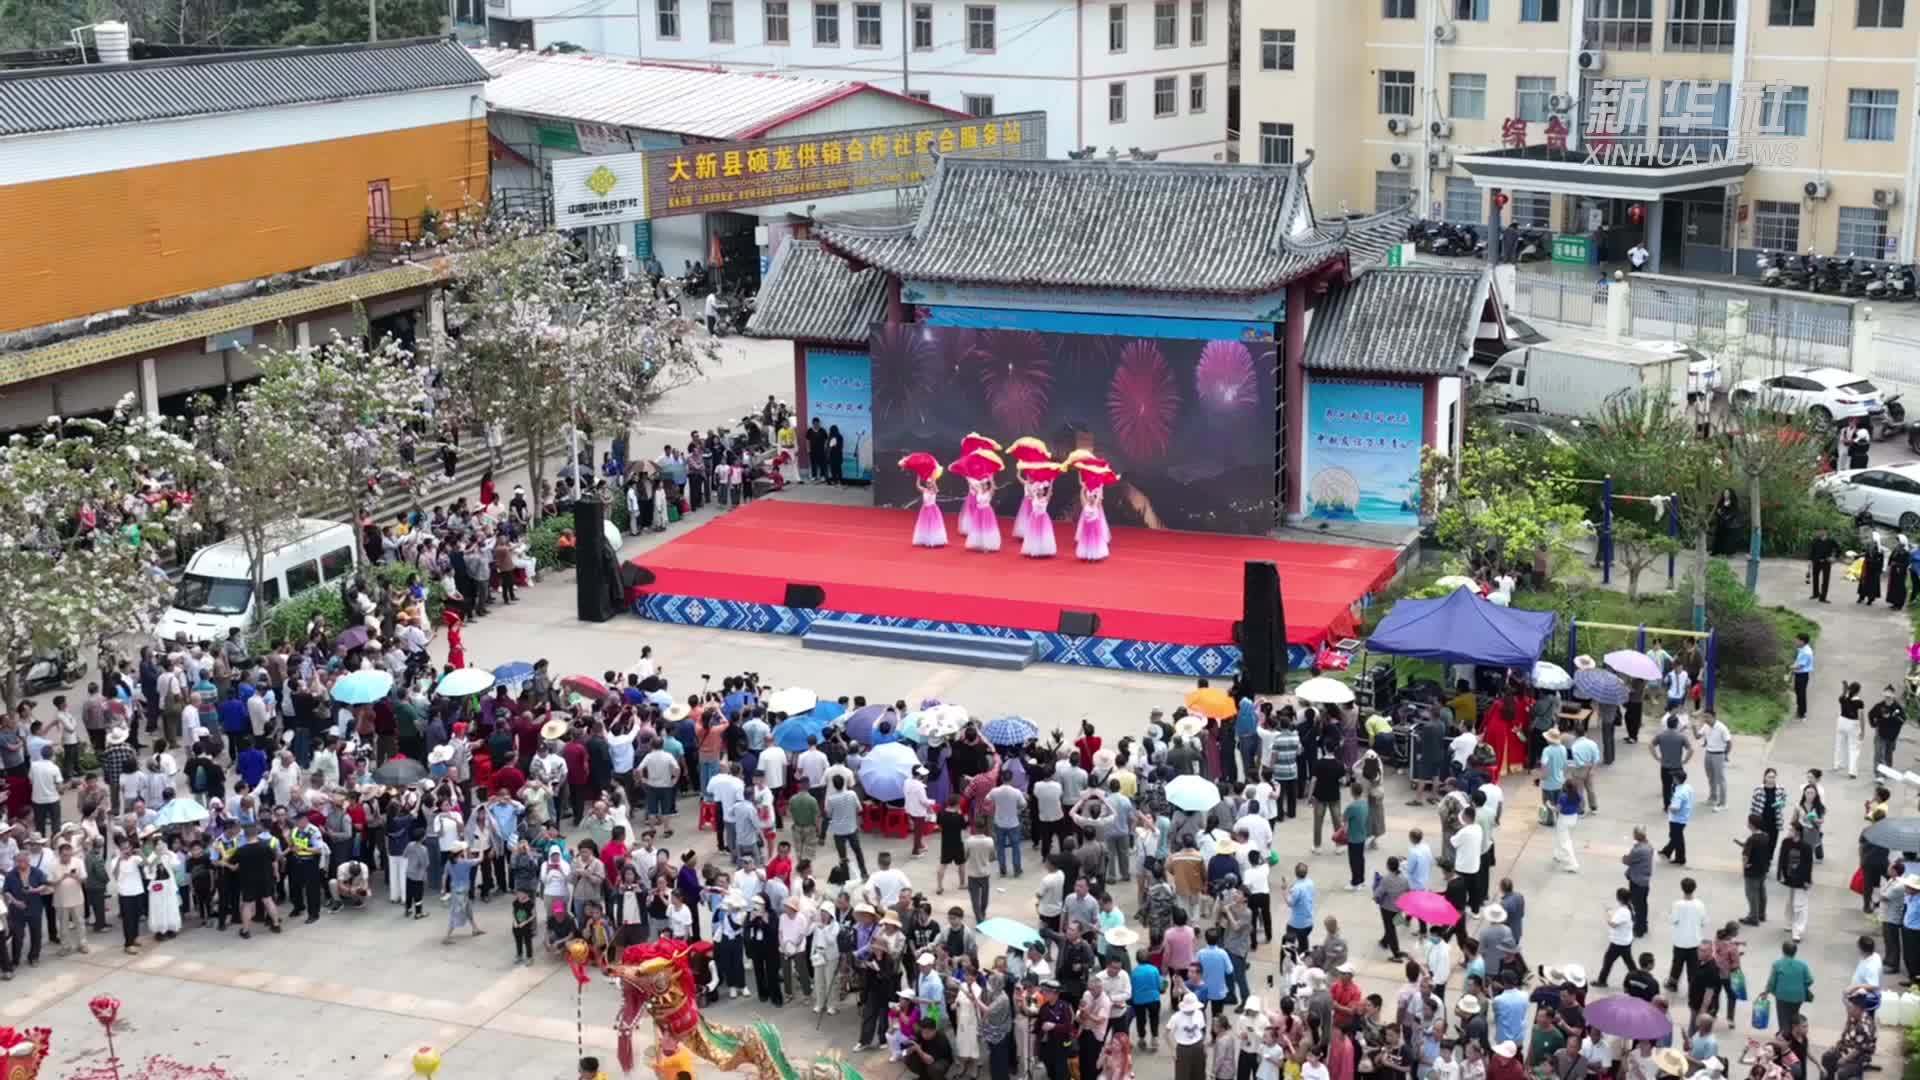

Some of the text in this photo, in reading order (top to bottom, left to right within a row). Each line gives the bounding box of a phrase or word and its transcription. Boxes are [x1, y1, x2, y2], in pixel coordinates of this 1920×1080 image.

[668, 120, 1022, 183] 大新县硕龙供销合作社综合服务站
